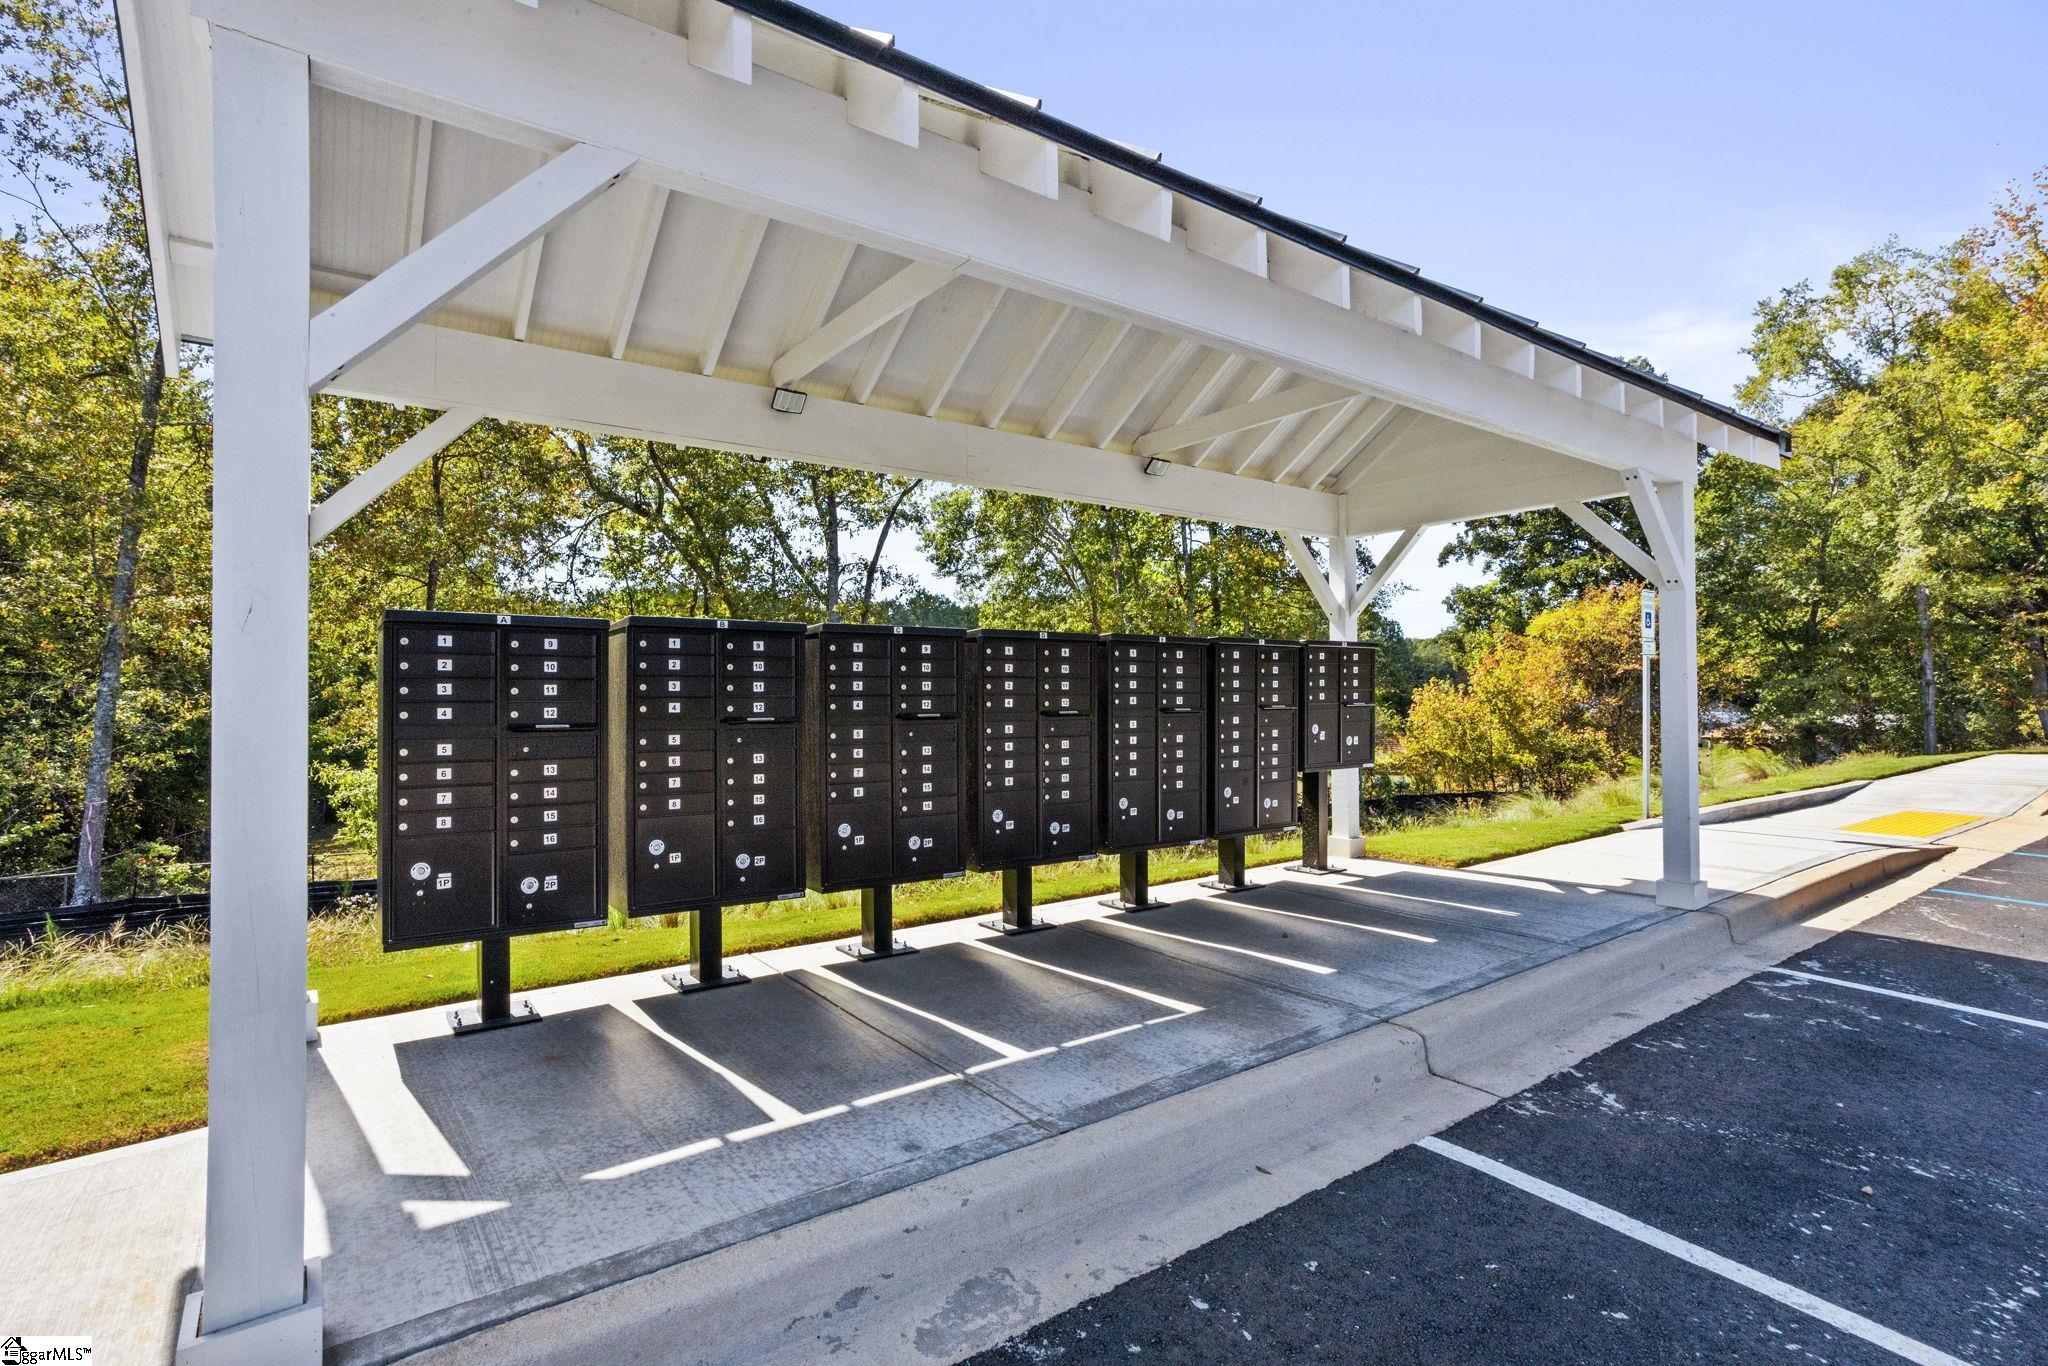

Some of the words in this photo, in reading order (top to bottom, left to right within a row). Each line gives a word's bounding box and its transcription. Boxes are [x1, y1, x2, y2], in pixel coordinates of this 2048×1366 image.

[500, 616, 508, 624] A
[442, 637, 447, 645] 1
[547, 640, 554, 648] 9
[755, 642, 761, 650] 9
[442, 661, 448, 669] 2
[546, 663, 556, 671] 10
[441, 685, 447, 693] 3
[671, 682, 677, 690] 3
[545, 709, 556, 717] 12
[672, 736, 677, 744] 5
[441, 746, 447, 754] 5
[441, 770, 447, 778] 6
[546, 766, 556, 774] 13
[441, 794, 447, 802] 7
[672, 800, 677, 808] 8
[546, 812, 556, 820] 15
[440, 818, 447, 827] 8
[546, 835, 555, 843] 16
[855, 836, 864, 844] 1P
[670, 854, 680, 862] 1P
[755, 857, 765, 865] 2P
[438, 879, 450, 887] 1P
[545, 881, 556, 889] 2P
